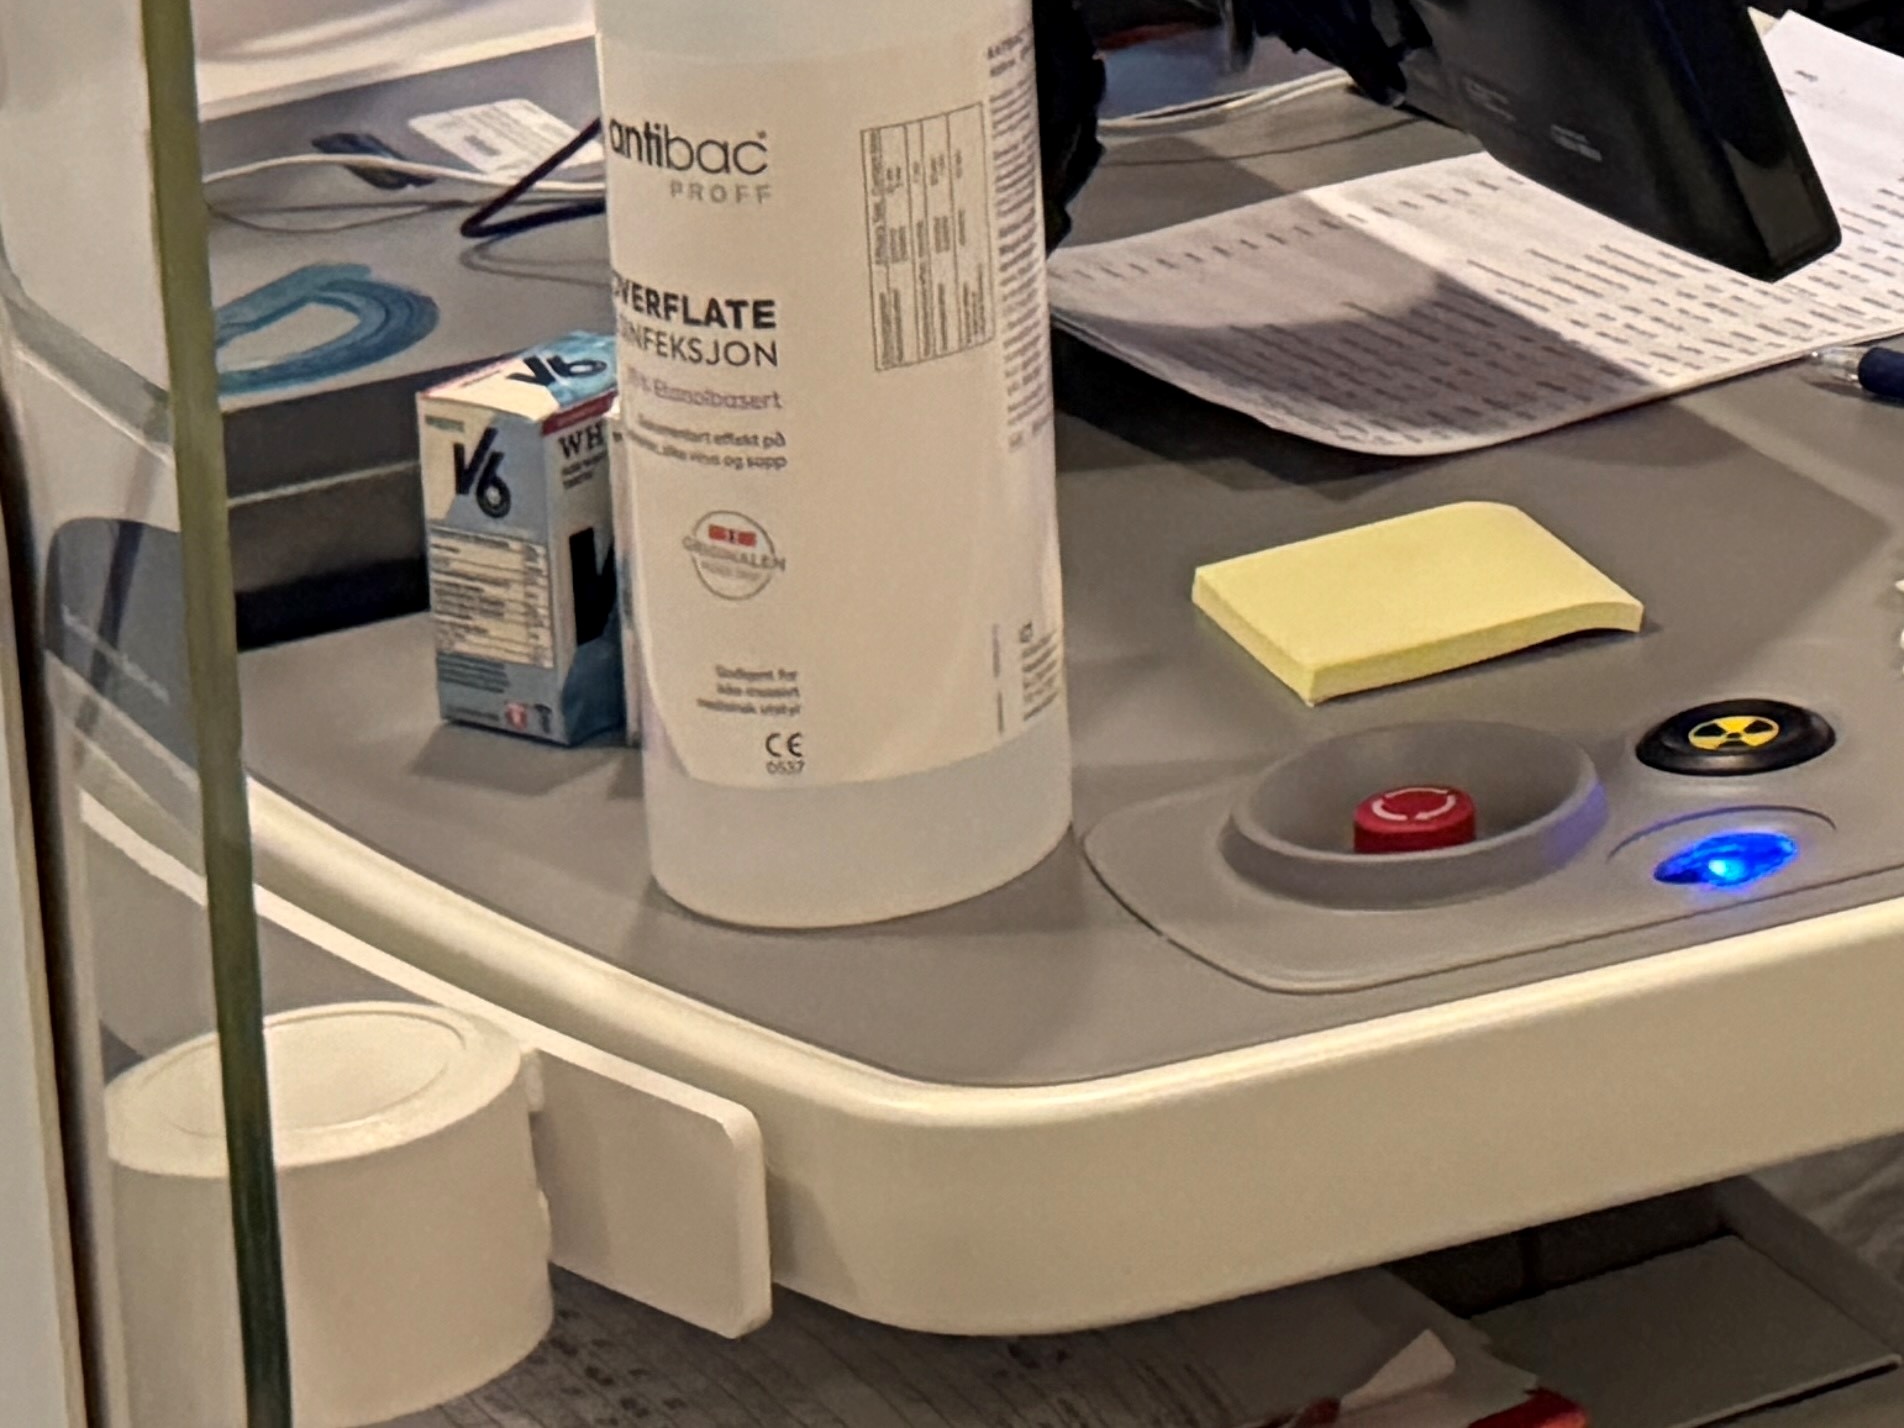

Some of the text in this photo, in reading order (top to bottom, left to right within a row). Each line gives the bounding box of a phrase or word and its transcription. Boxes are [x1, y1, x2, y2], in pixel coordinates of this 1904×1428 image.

[609, 118, 768, 176] antibac
[670, 180, 772, 205] PROFF
[506, 355, 607, 387] V6
[762, 430, 786, 450] på
[453, 426, 512, 519] V6
[723, 455, 744, 470] og
[764, 731, 803, 758] CE
